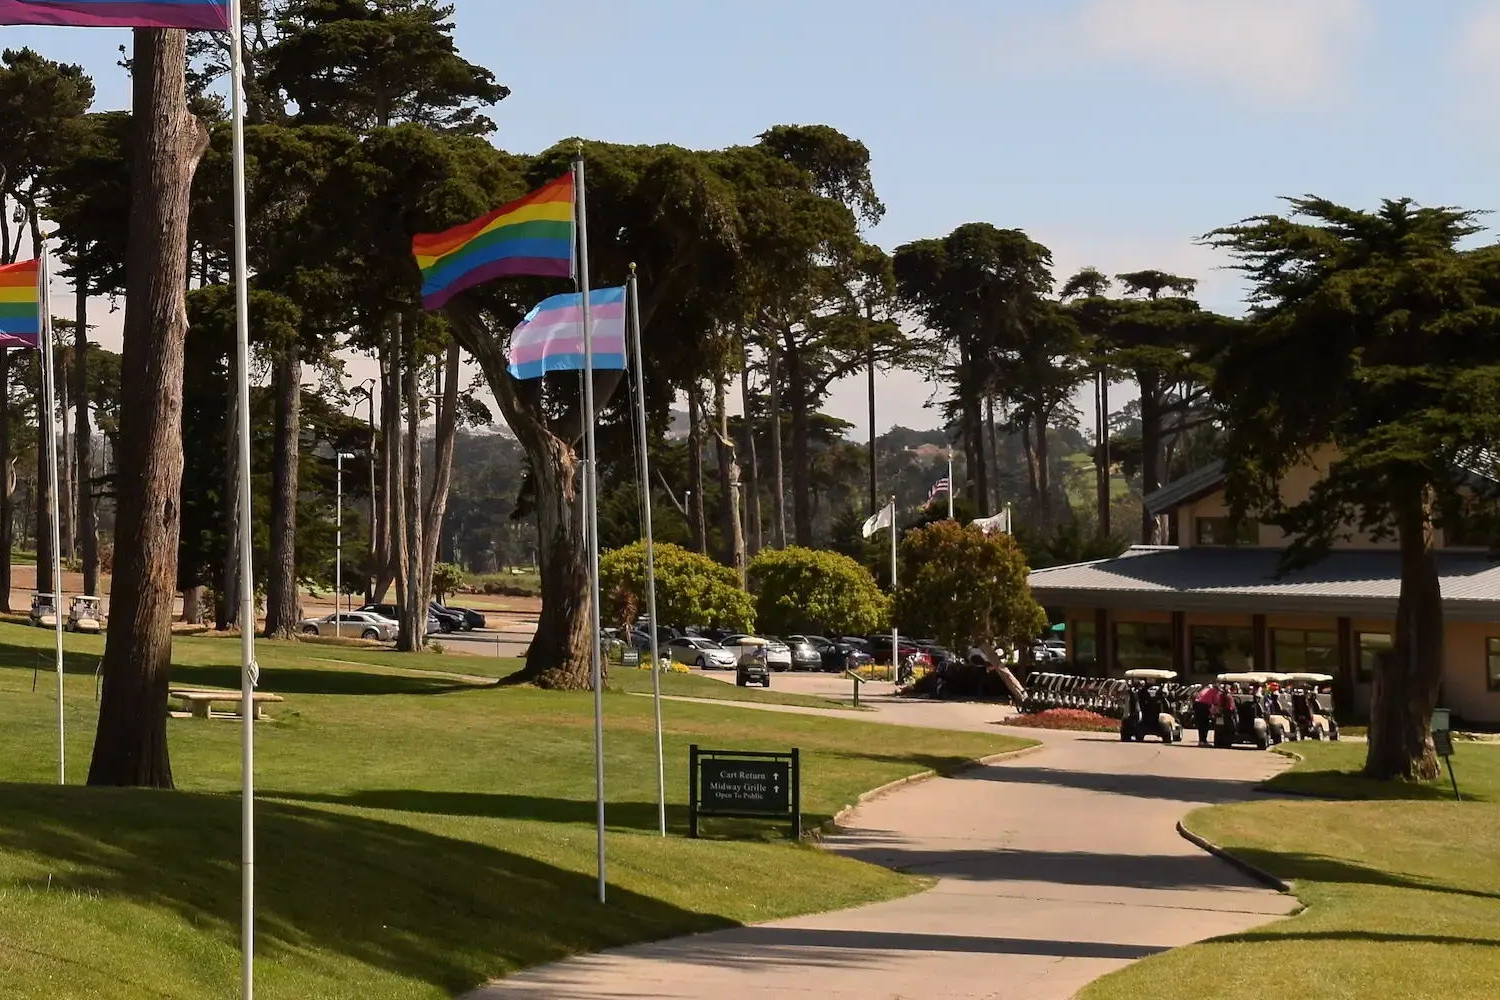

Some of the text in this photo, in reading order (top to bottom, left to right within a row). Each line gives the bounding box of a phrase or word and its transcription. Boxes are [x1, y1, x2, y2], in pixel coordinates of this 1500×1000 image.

[720, 770, 766, 779] Cart Return
[709, 782, 767, 792] Midway Grille
